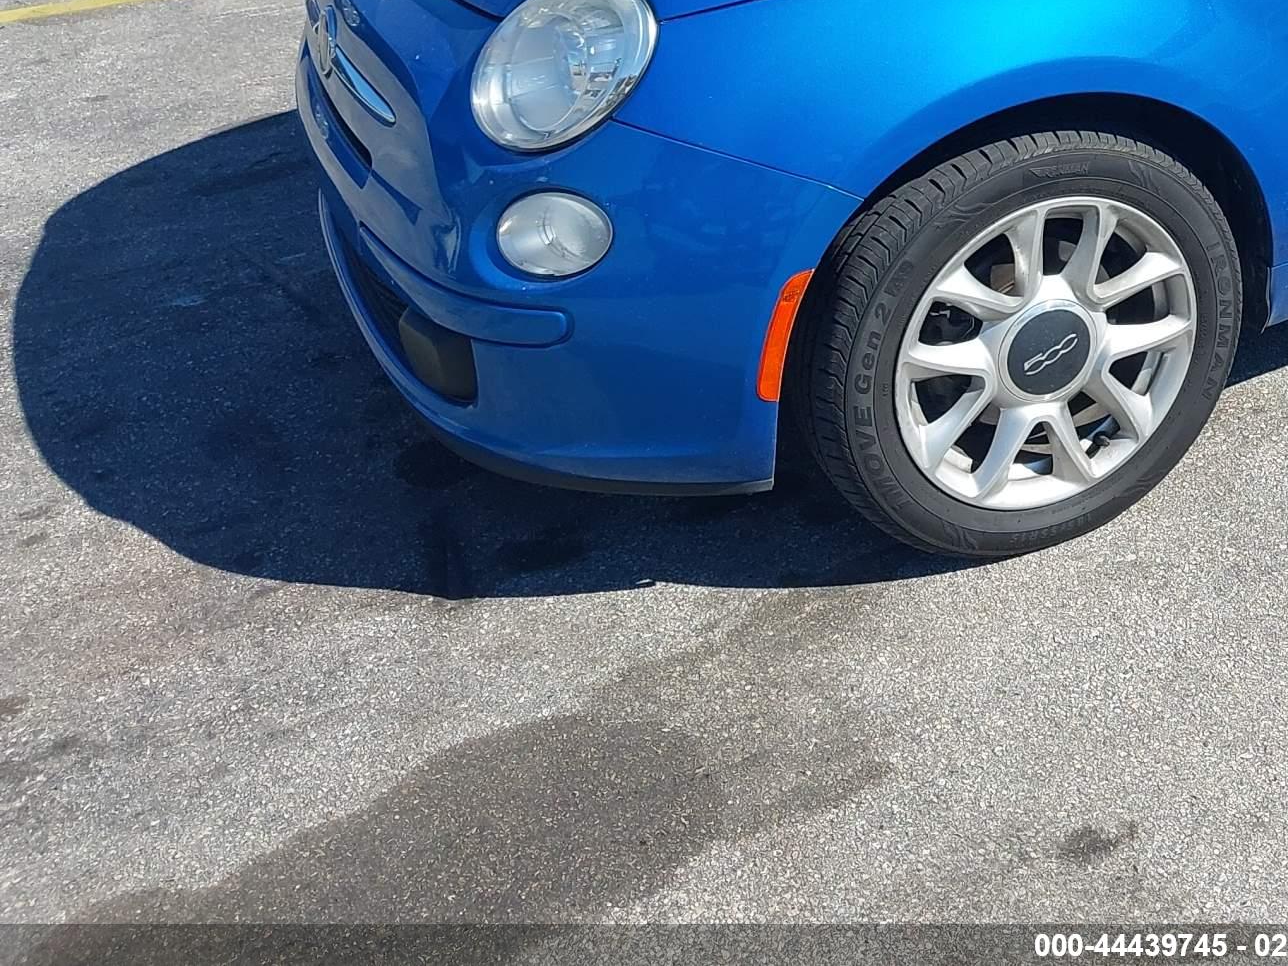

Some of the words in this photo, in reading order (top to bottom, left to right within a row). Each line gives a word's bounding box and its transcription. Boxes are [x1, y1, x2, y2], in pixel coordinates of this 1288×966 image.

[855, 331, 881, 395] Gen
[874, 304, 892, 323] 2
[1204, 242, 1234, 401] IRONMAN
